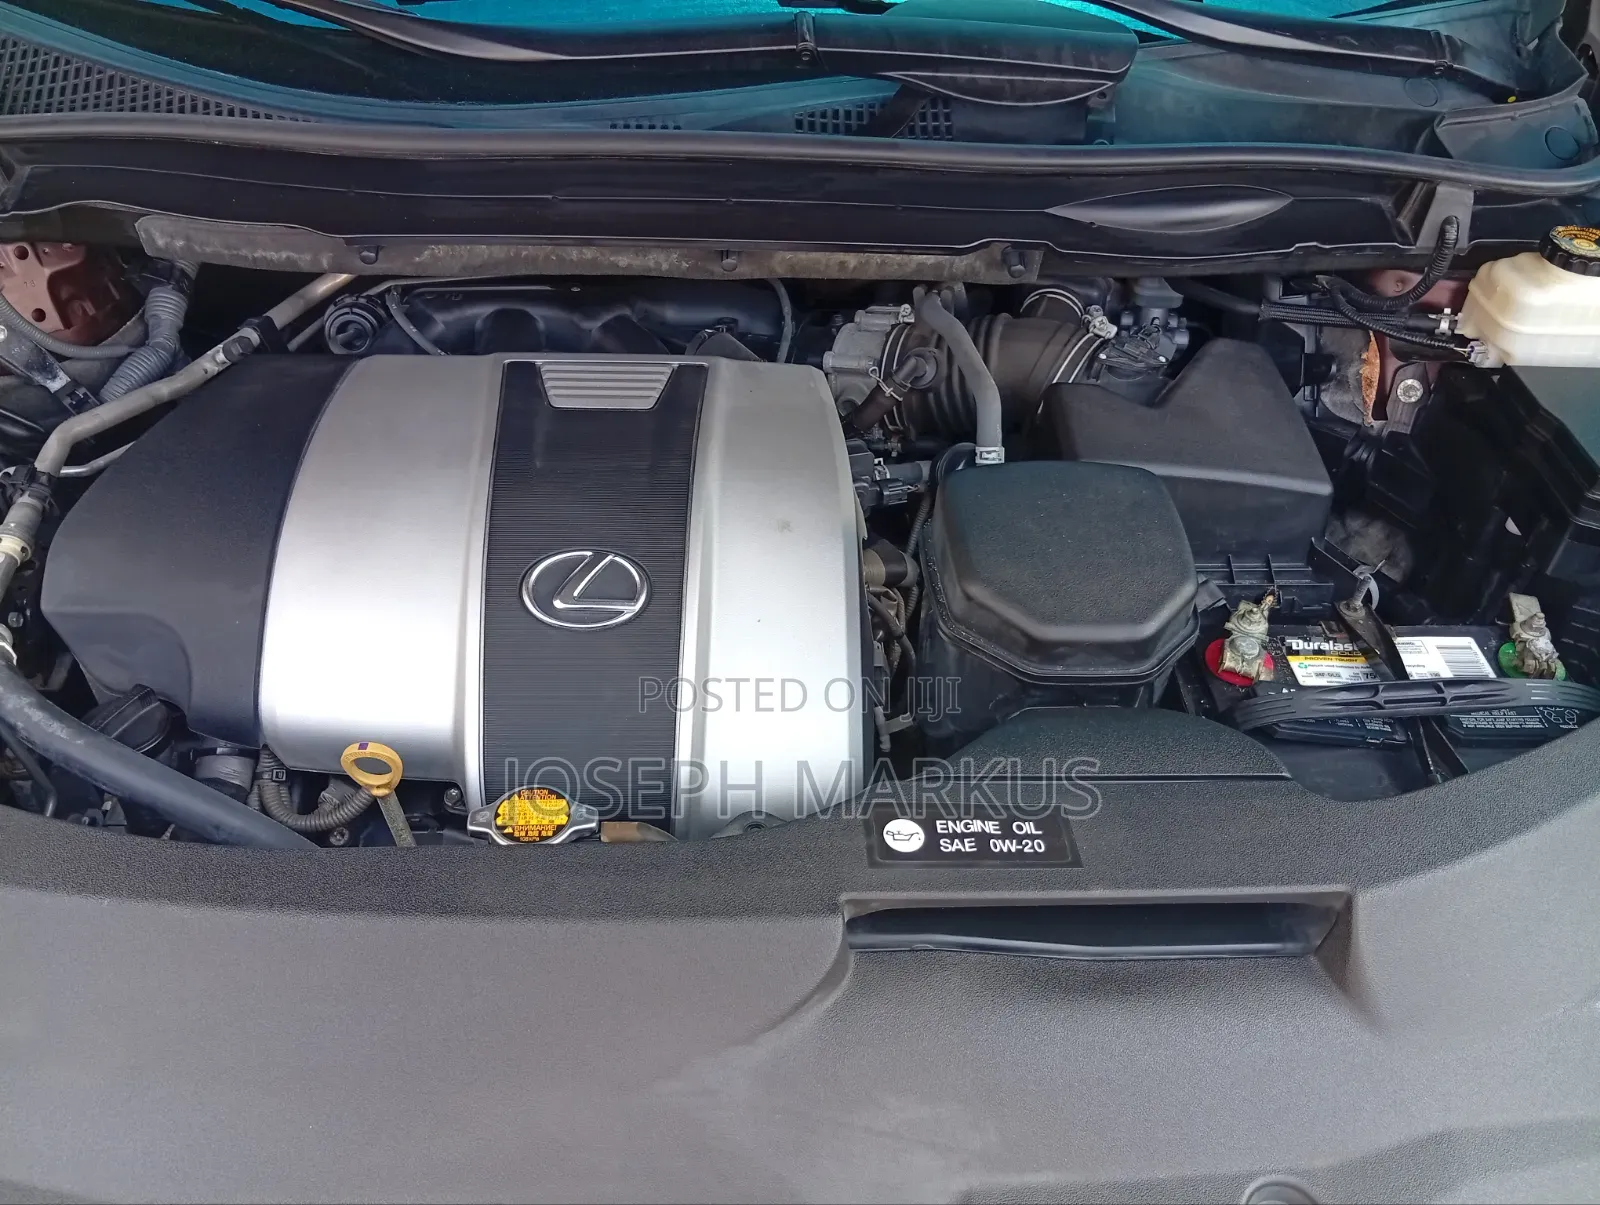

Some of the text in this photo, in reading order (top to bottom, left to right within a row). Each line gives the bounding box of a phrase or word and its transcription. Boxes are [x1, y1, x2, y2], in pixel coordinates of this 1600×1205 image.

[1364, 672, 1376, 680] 75
[935, 819, 1043, 835] ENGINE OIL
[939, 838, 1045, 853] SAE 0W-20
